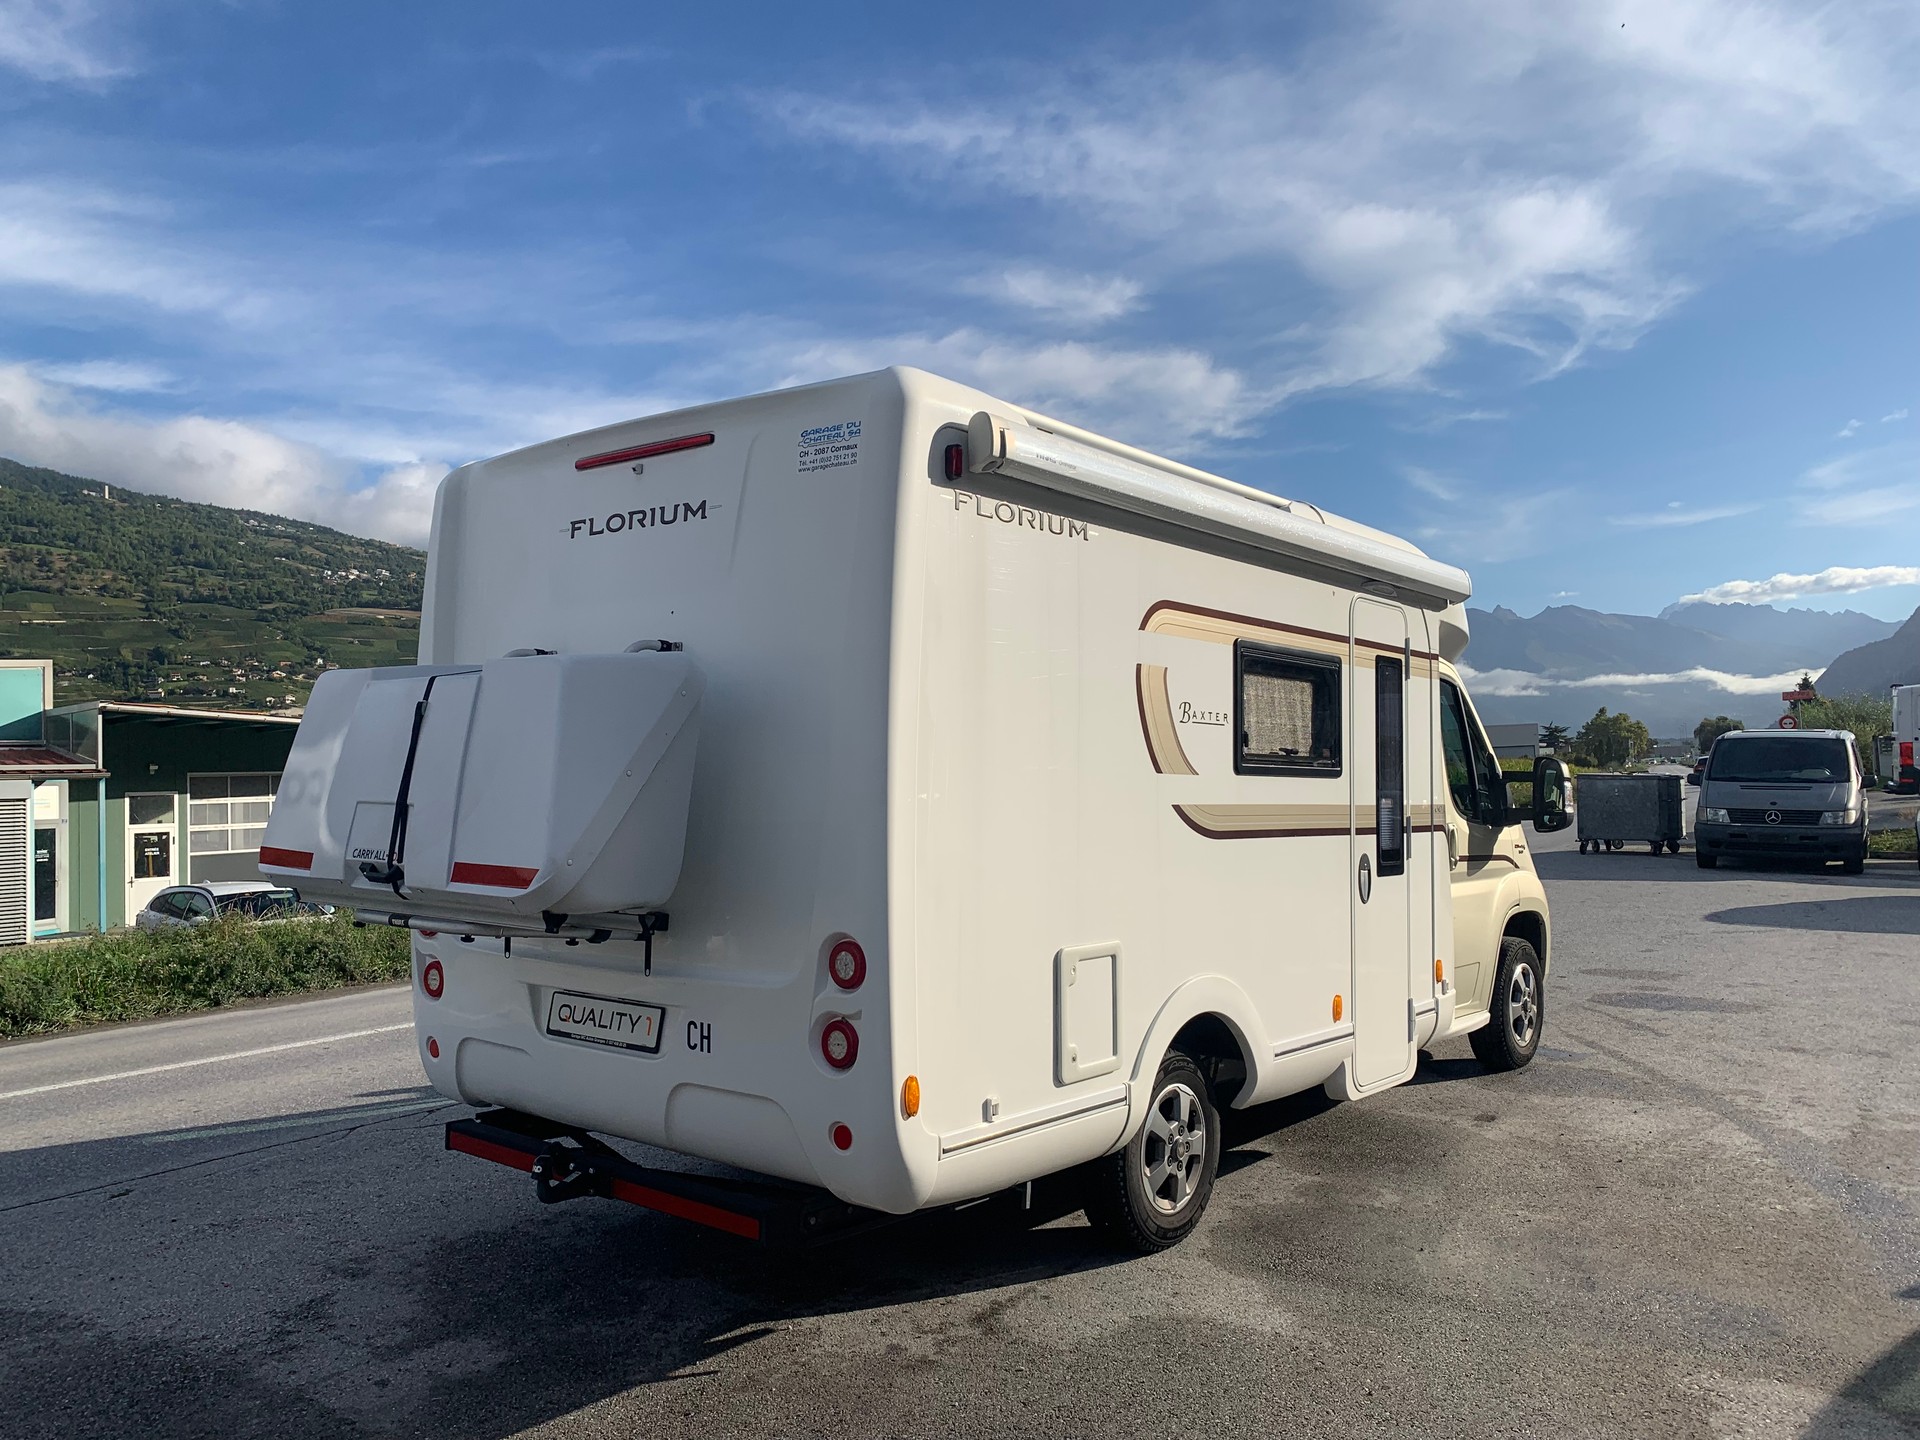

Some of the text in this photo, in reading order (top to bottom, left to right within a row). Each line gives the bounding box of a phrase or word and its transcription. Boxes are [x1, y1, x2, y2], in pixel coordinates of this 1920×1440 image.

[801, 421, 861, 437] GARAGE DU
[803, 431, 845, 444] CHATEAU
[814, 447, 829, 455] 2087
[831, 443, 858, 453] Cornaux
[570, 500, 707, 539] FLORIUM
[954, 489, 1089, 541] FLORIUM
[353, 849, 374, 860] CARRY
[558, 1004, 653, 1036] QUALITY 1
[687, 1020, 711, 1054] CH
